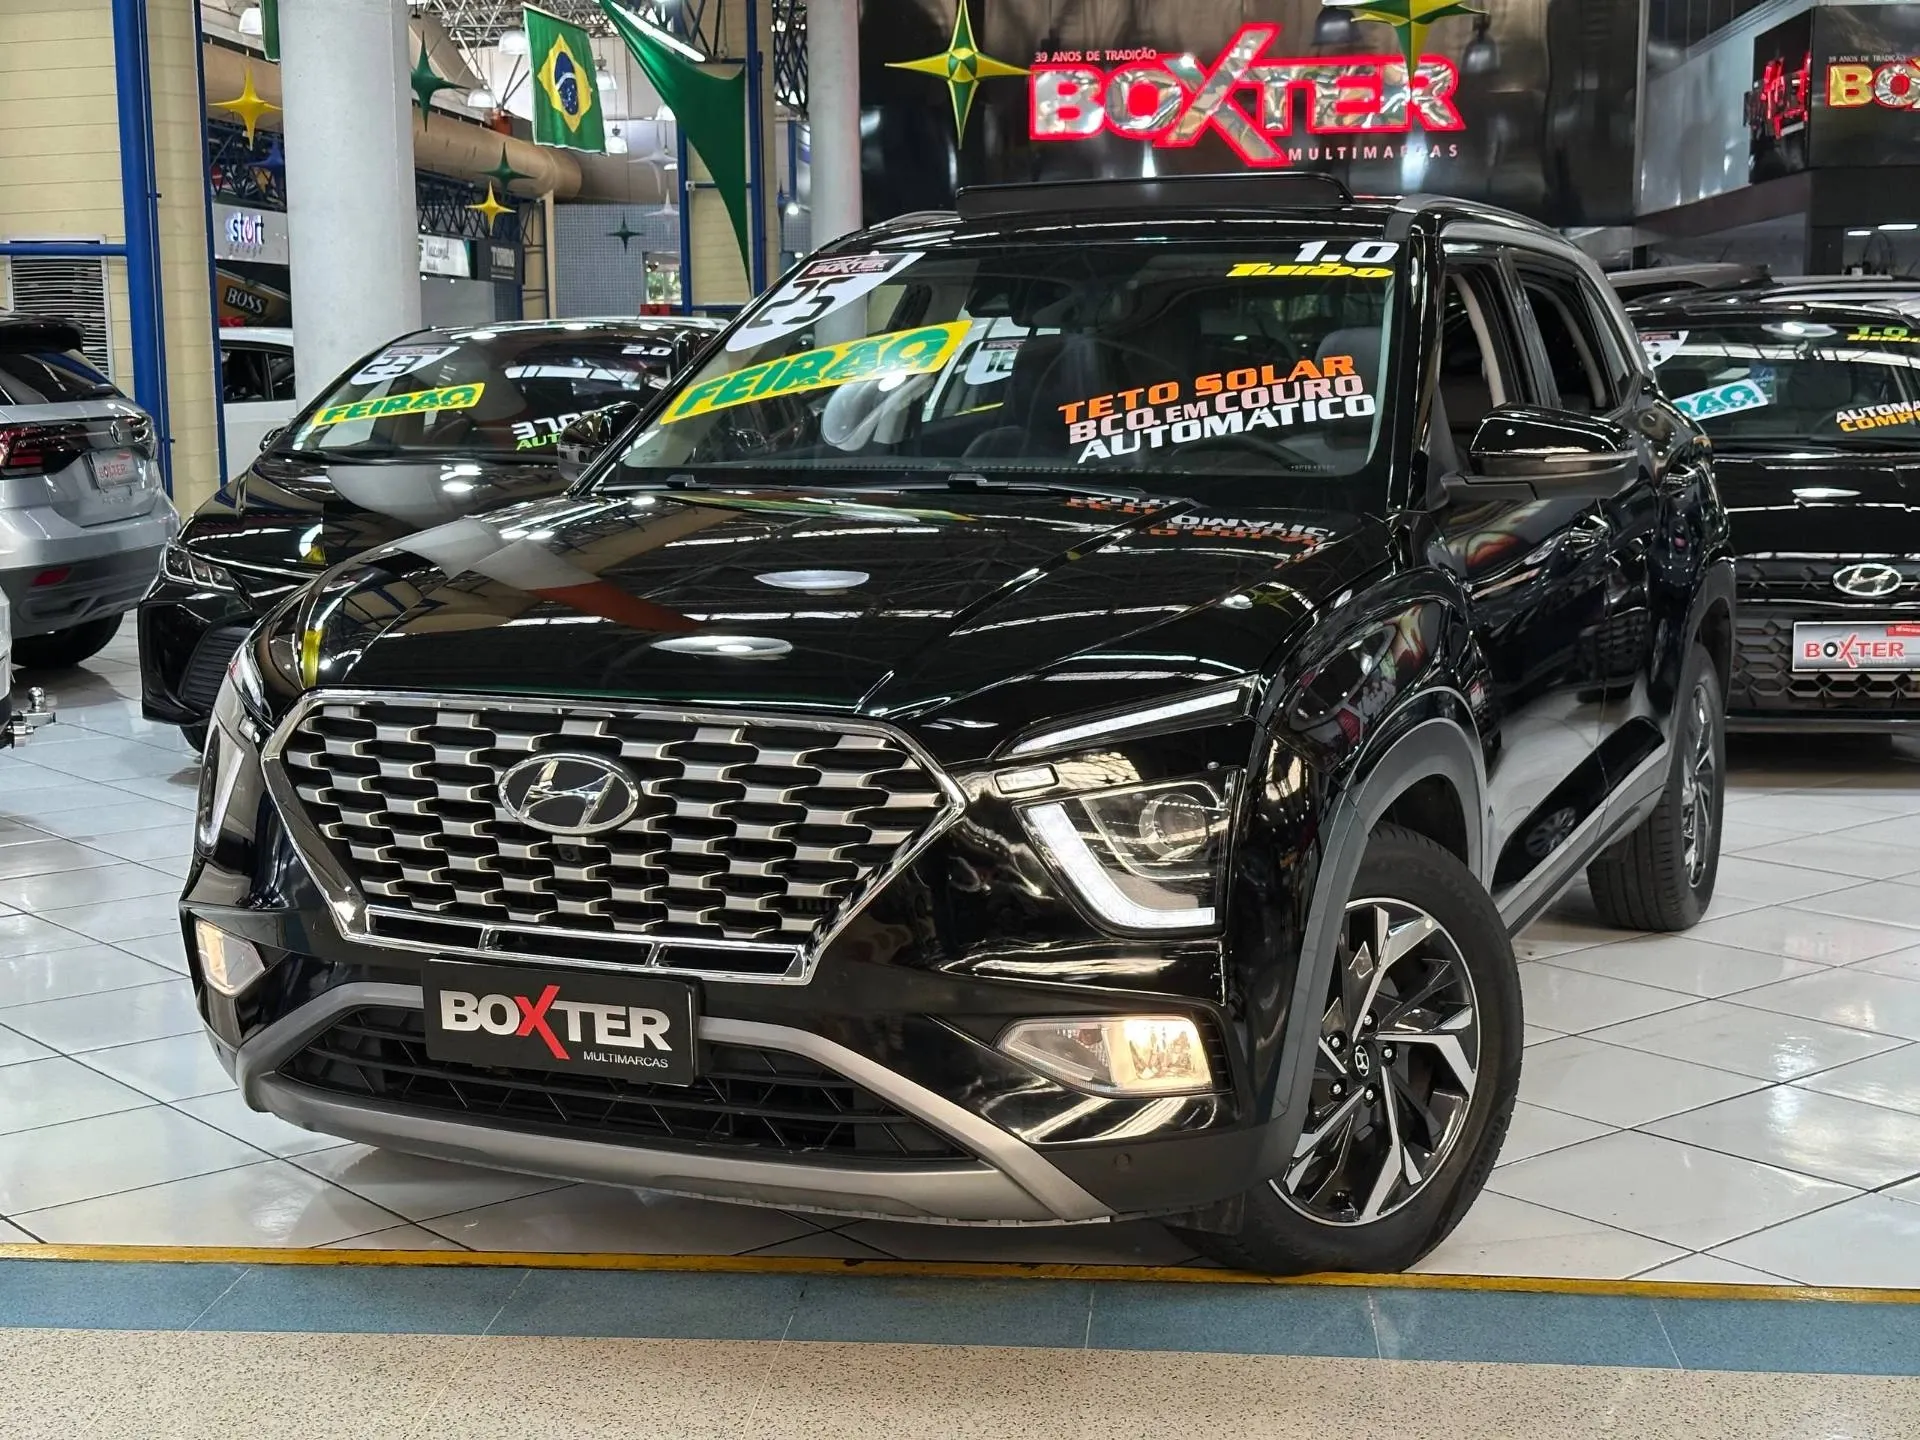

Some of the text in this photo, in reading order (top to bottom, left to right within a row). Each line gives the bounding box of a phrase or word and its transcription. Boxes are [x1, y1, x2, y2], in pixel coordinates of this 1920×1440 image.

[1034, 46, 1157, 63] 39 ANOS DE TRADIÇÃO
[1029, 22, 1467, 168] BOXTER
[1294, 240, 1400, 263] 1.0
[809, 257, 890, 276] BOXTER
[1226, 262, 1394, 278] Turbo
[227, 287, 263, 314] BOSS
[621, 345, 673, 357] 2.0
[673, 328, 950, 418] FEIRÃO
[1057, 355, 1355, 425] TETO SOLAR
[324, 387, 476, 421] FEIRÃO
[1069, 374, 1364, 445] BCO. EM COURO
[1077, 394, 1376, 464] AUTOMÁTICO
[1840, 410, 1920, 432] COMP
[516, 433, 561, 451] AUT
[1803, 632, 1905, 668] BOXTER
[440, 985, 672, 1060] BOXTER
[584, 1051, 668, 1069] MULTIMARCAS
